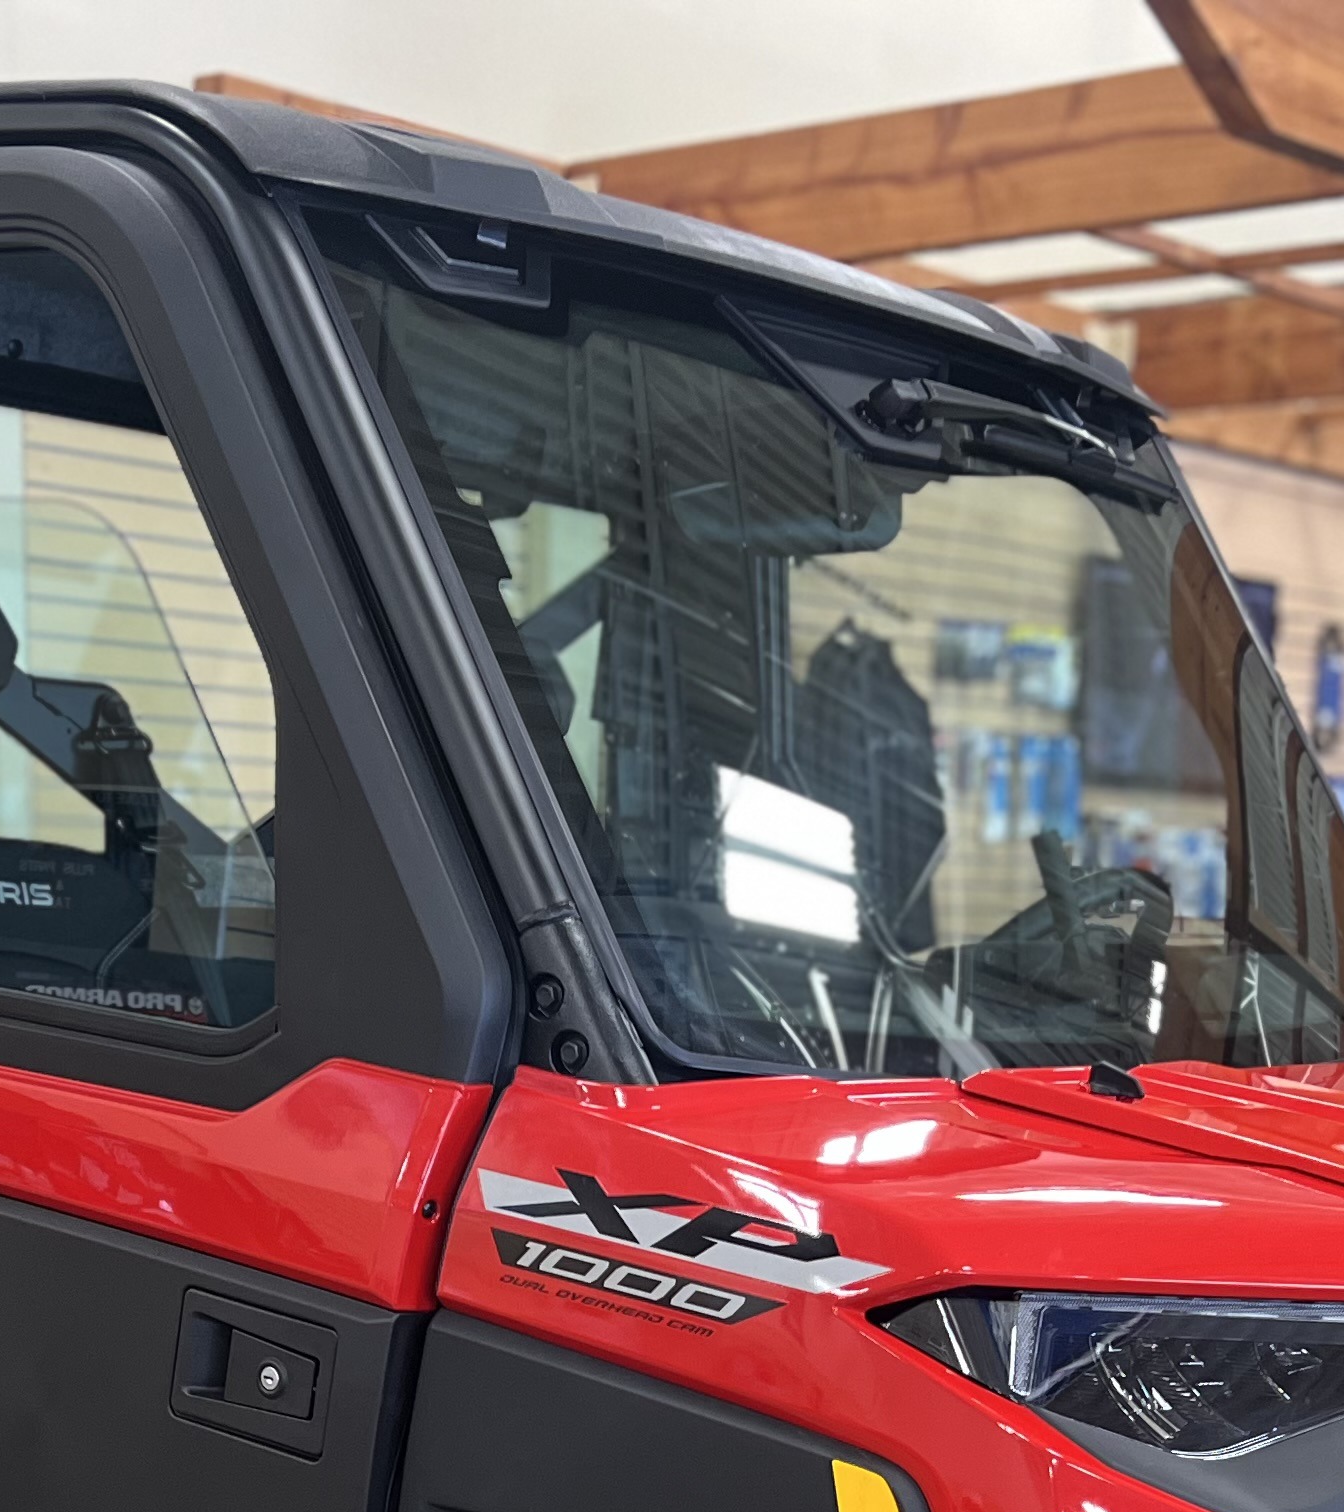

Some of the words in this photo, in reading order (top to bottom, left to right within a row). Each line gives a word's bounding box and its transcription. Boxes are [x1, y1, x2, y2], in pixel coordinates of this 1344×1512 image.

[494, 1167, 841, 1264] XP
[499, 1274, 550, 1294] DUAL
[557, 1289, 663, 1325] OVERHEAD
[667, 1319, 714, 1338] CAM
[514, 1241, 747, 1320] 1000
